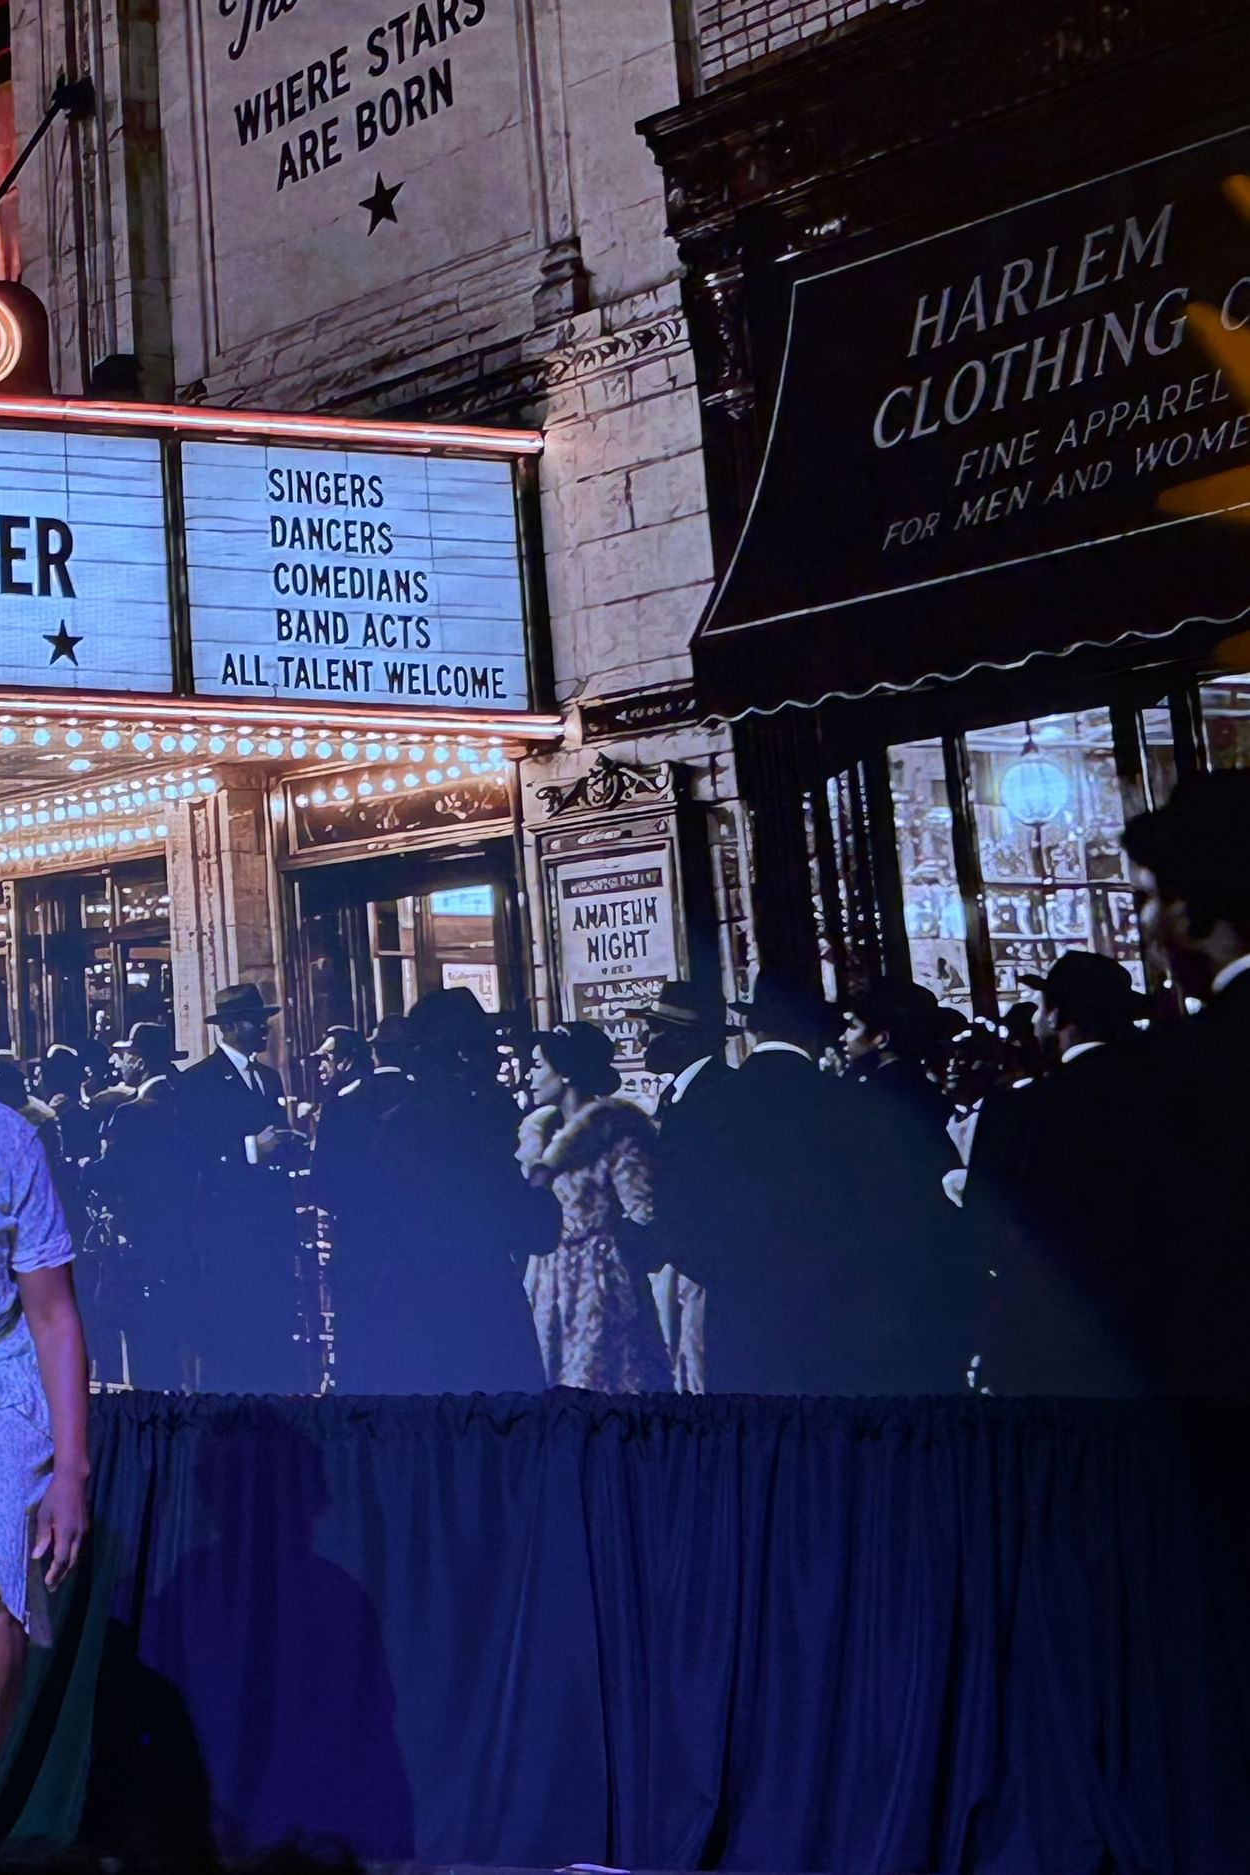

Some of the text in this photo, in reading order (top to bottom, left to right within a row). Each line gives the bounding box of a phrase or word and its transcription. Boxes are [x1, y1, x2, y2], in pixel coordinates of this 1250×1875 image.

[234, 0, 486, 146] WHERE STARS
[276, 58, 454, 192] ARE BORN
[906, 203, 1174, 358] HARLEM
[872, 287, 1190, 449] CLOTHING
[954, 369, 1230, 488] FINE APPAREL
[268, 468, 384, 508] SINGERS
[882, 512, 941, 551] FOR
[954, 480, 1032, 531] MEN
[1044, 459, 1113, 503] AND
[269, 515, 393, 554] DANCERS
[273, 562, 428, 604] COMEDIANS
[276, 609, 431, 649] BAND ACTS
[222, 653, 507, 699] ALL TALENT WELCOME
[587, 929, 650, 963] NIGHT
